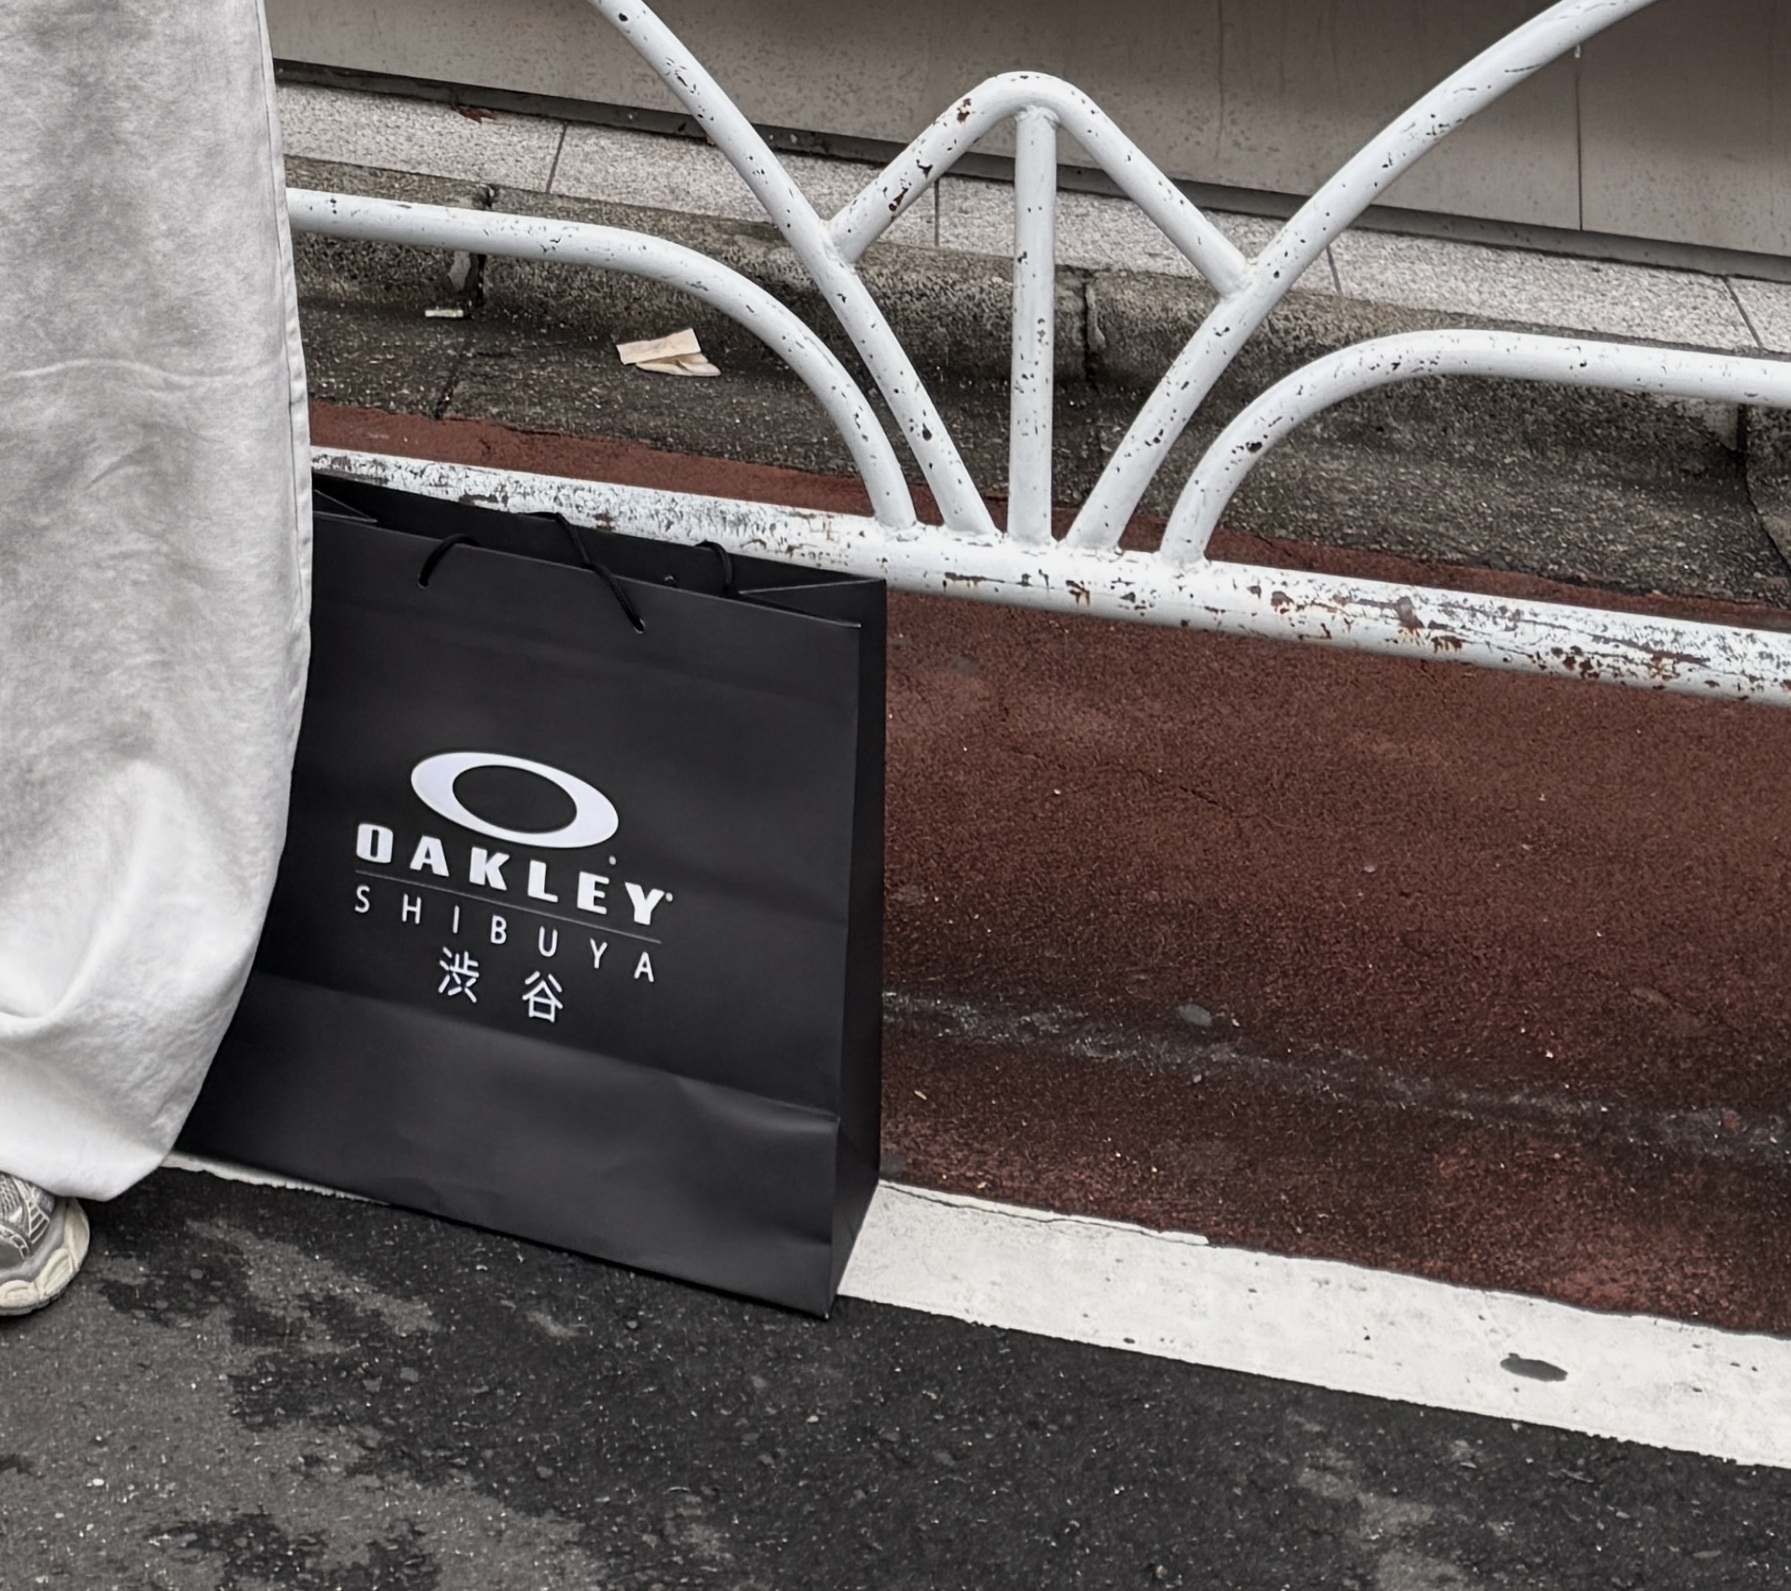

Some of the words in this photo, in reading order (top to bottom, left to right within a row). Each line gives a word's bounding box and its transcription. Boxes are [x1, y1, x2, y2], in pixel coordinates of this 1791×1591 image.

[355, 822, 665, 926] OAKLEY
[354, 884, 655, 983] SHIBUYA
[437, 946, 564, 1023] 渋谷
